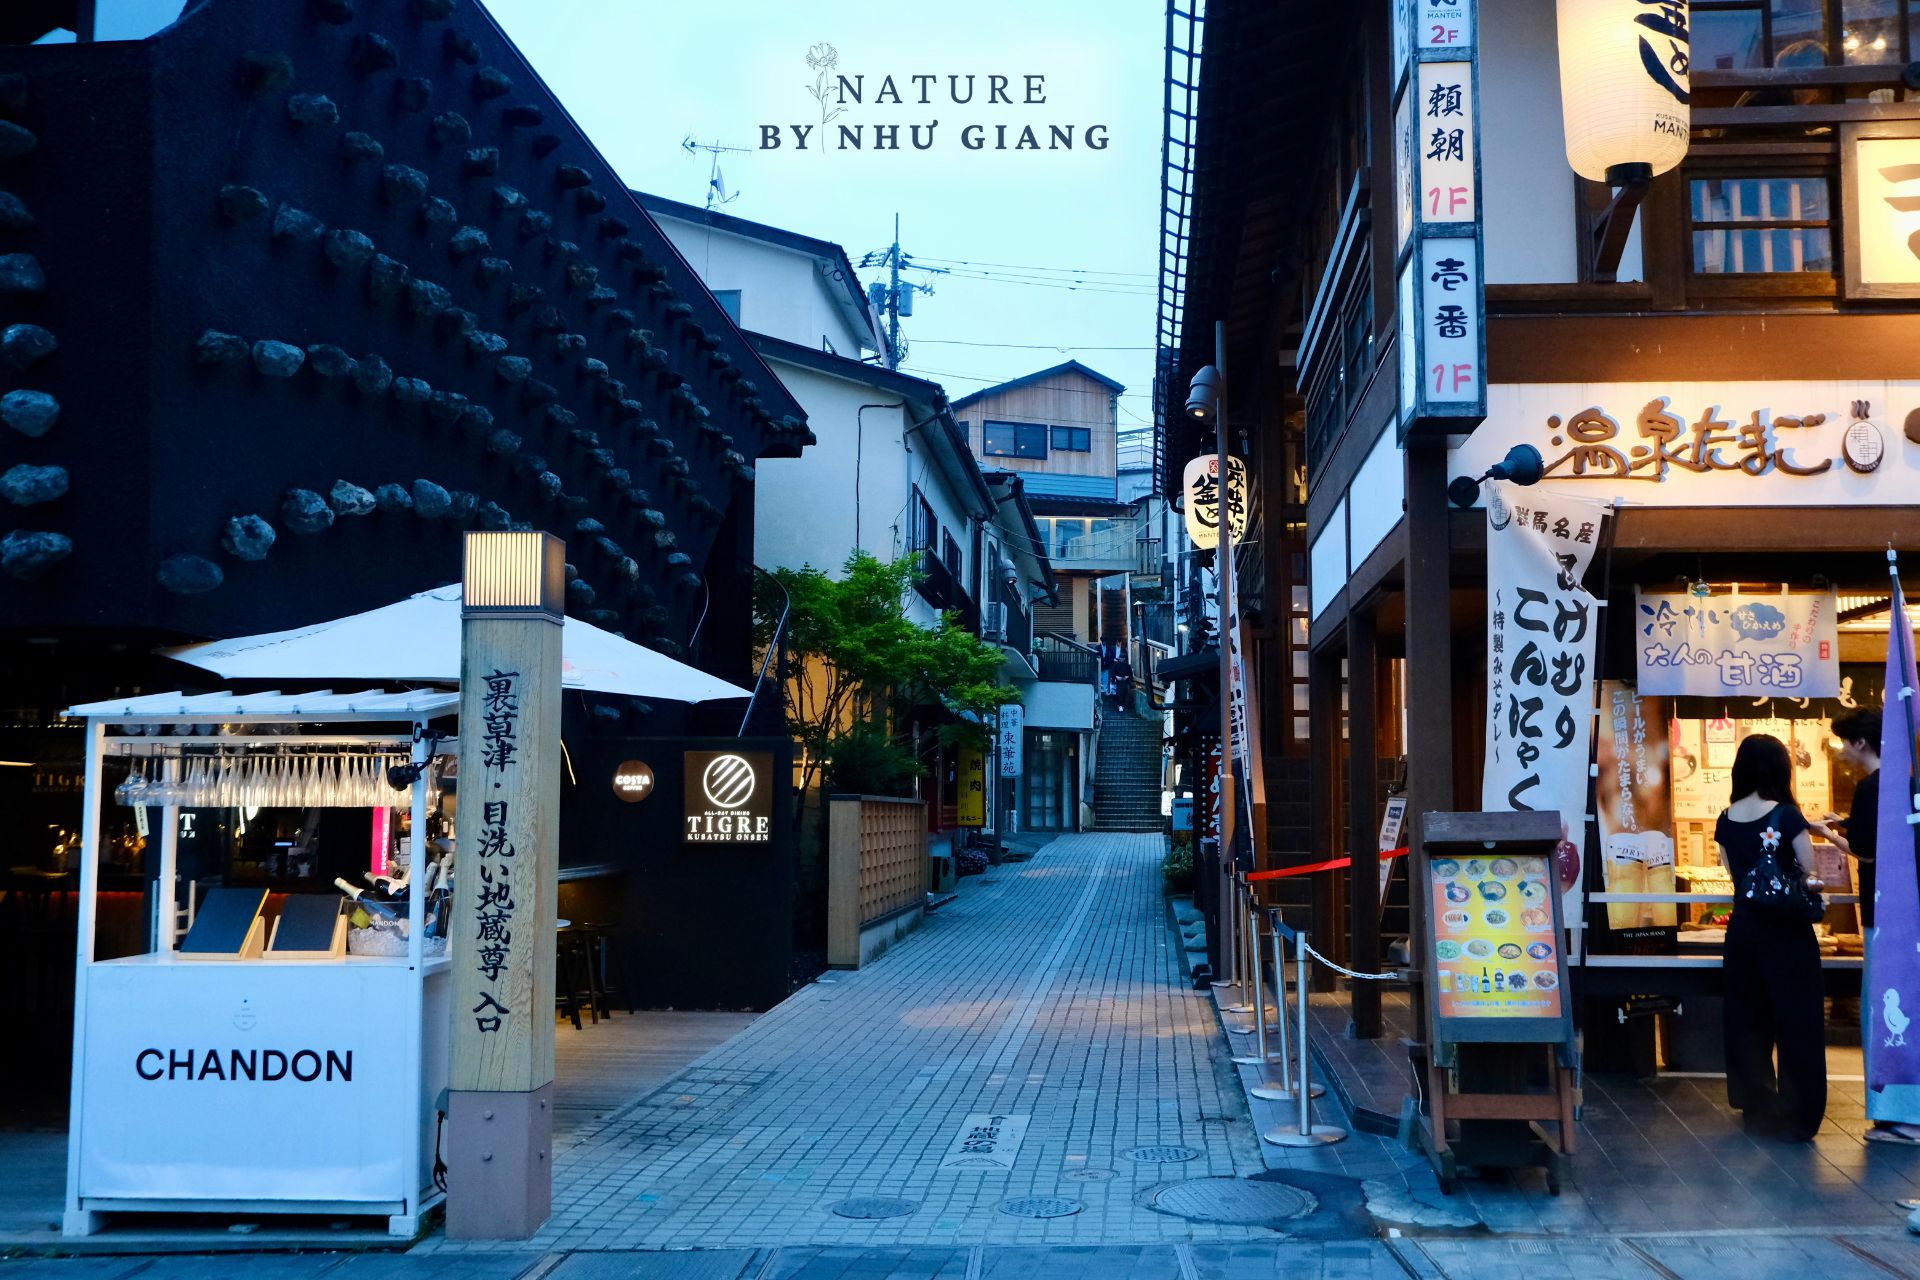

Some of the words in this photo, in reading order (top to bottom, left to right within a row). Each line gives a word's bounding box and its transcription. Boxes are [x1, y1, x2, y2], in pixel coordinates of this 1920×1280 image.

[1430, 25, 1459, 43] 2F
[1427, 84, 1464, 162] 頼朝
[1428, 186, 1468, 216] 1F
[1431, 258, 1468, 338] 壱番
[1432, 363, 1472, 394] 1F
[1543, 399, 1832, 482] 温泉たまご
[1515, 505, 1595, 544] 群馬名産
[1508, 586, 1549, 812] こんにゃく
[1002, 731, 1016, 774] 東華苑
[32, 773, 85, 786] TIGR
[615, 774, 650, 785] COSTA
[969, 760, 982, 792] 焼肉
[687, 816, 769, 833] TIGRE
[687, 833, 732, 841] KUSATSU
[736, 833, 769, 841] ONSEN
[381, 823, 389, 871] PERONI
[473, 991, 511, 1033] 入口
[136, 1048, 353, 1082] CHANDON
